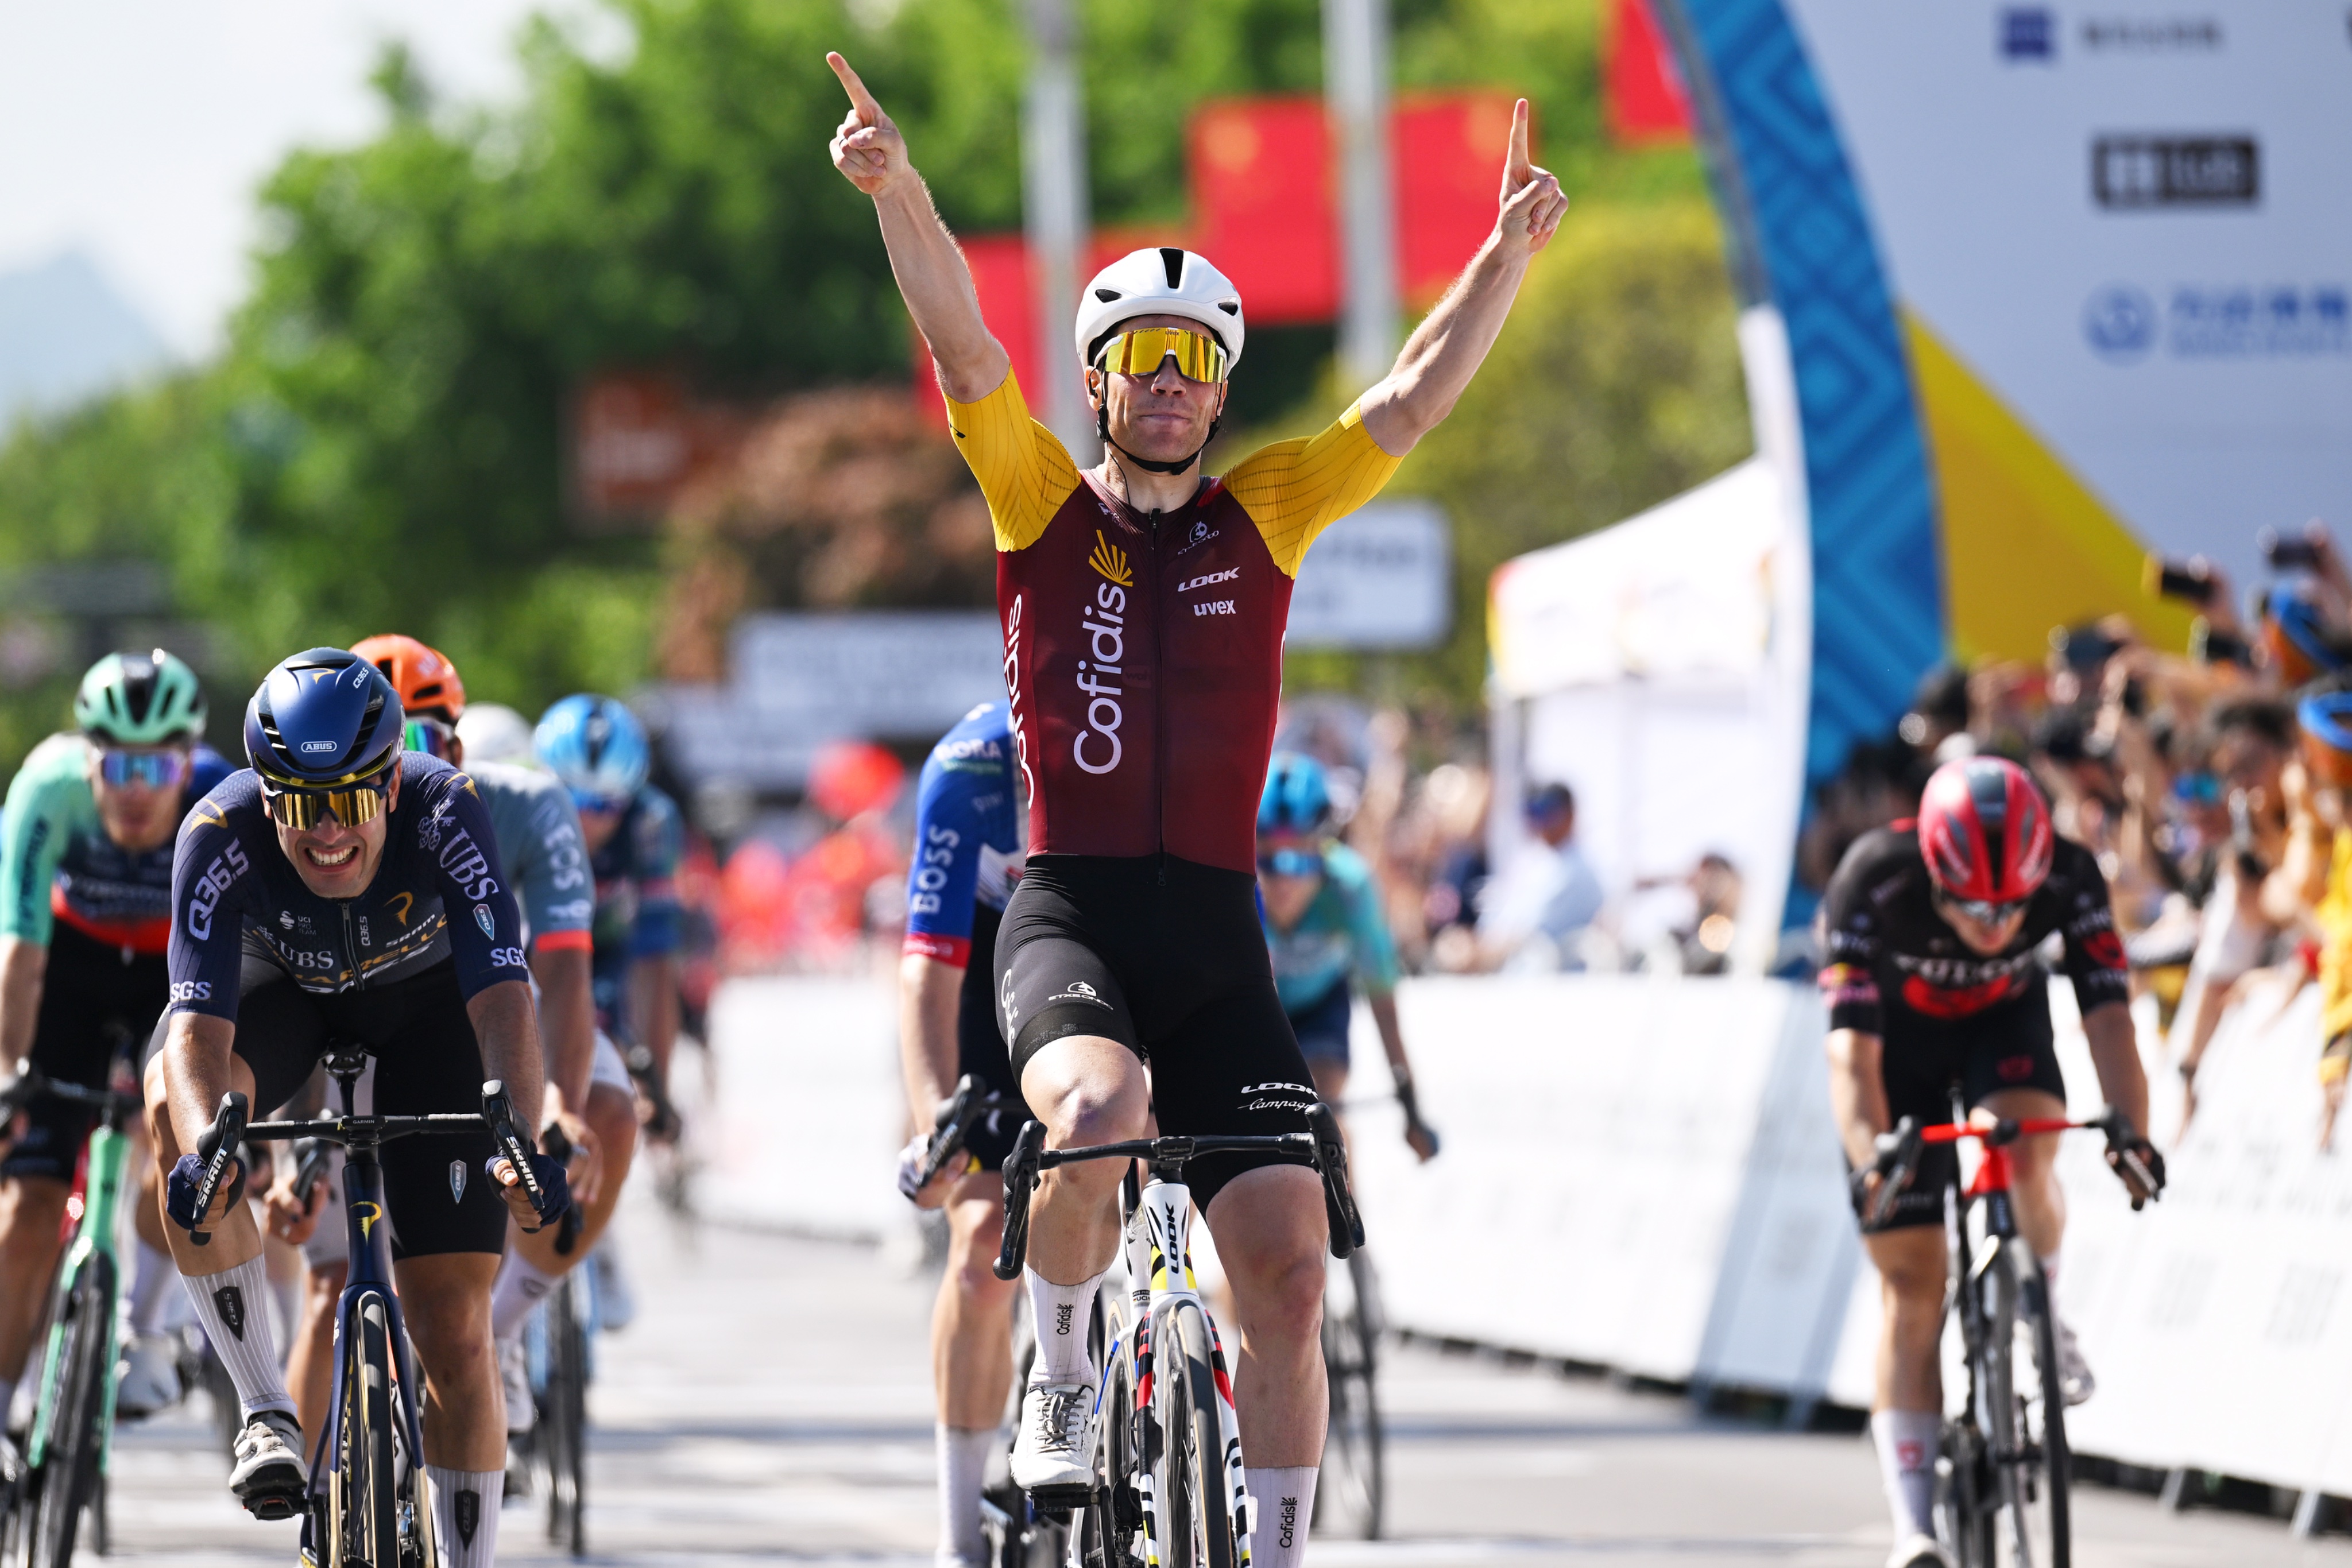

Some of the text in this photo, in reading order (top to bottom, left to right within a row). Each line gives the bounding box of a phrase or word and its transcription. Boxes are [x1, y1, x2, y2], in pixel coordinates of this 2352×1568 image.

[1178, 567, 1240, 592] LOOK
[1194, 600, 1236, 616] uvex
[1073, 582, 1125, 775] Cofidis
[439, 827, 499, 900] UBS
[912, 823, 960, 914] BOSS
[188, 837, 249, 941] Q36.5
[359, 915, 371, 946] Q36.5
[386, 914, 436, 948] SRAM
[279, 939, 334, 969] UBS
[490, 947, 527, 969] SGS
[171, 981, 211, 1001] SGS
[1237, 1098, 1311, 1112] Campagn
[1241, 1082, 1318, 1099] LOOK
[198, 1148, 227, 1207] SRAM
[506, 1136, 539, 1193] SRAM
[1166, 1202, 1176, 1274] LOOK
[1057, 1310, 1072, 1335] Cofidis
[1279, 1505, 1295, 1548] Cofidis
